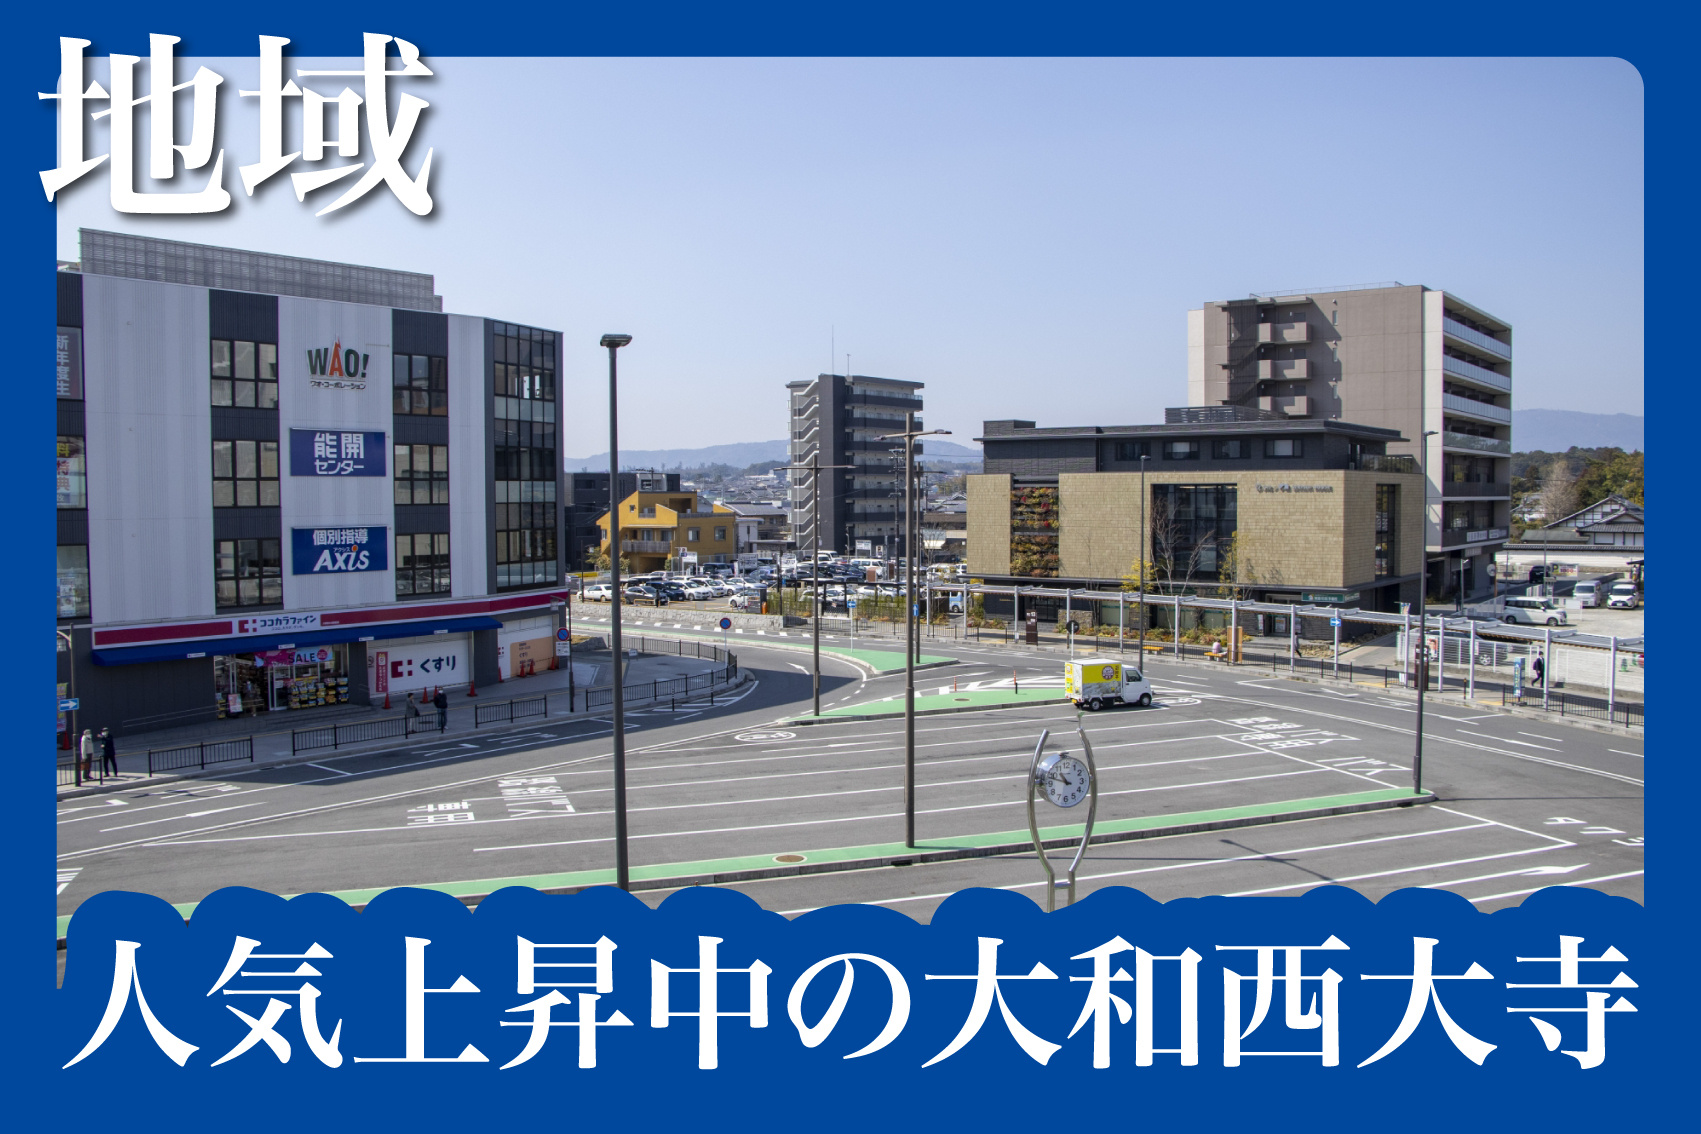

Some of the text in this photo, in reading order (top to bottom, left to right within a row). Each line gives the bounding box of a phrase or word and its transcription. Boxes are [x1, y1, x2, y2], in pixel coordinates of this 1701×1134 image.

[307, 336, 370, 379] WAO!
[314, 432, 364, 459] 能開
[314, 459, 365, 475] センター
[313, 529, 369, 546] 個別指導
[260, 615, 317, 628] ココカラファイン
[288, 651, 319, 664] SALE
[420, 655, 456, 673] くすり
[1063, 761, 1070, 769] 12
[1077, 769, 1083, 777] 2
[1048, 780, 1053, 788] 9
[1079, 777, 1085, 785] 3
[1050, 788, 1056, 796] 8
[1057, 793, 1062, 801] 7
[1063, 795, 1069, 803] 6
